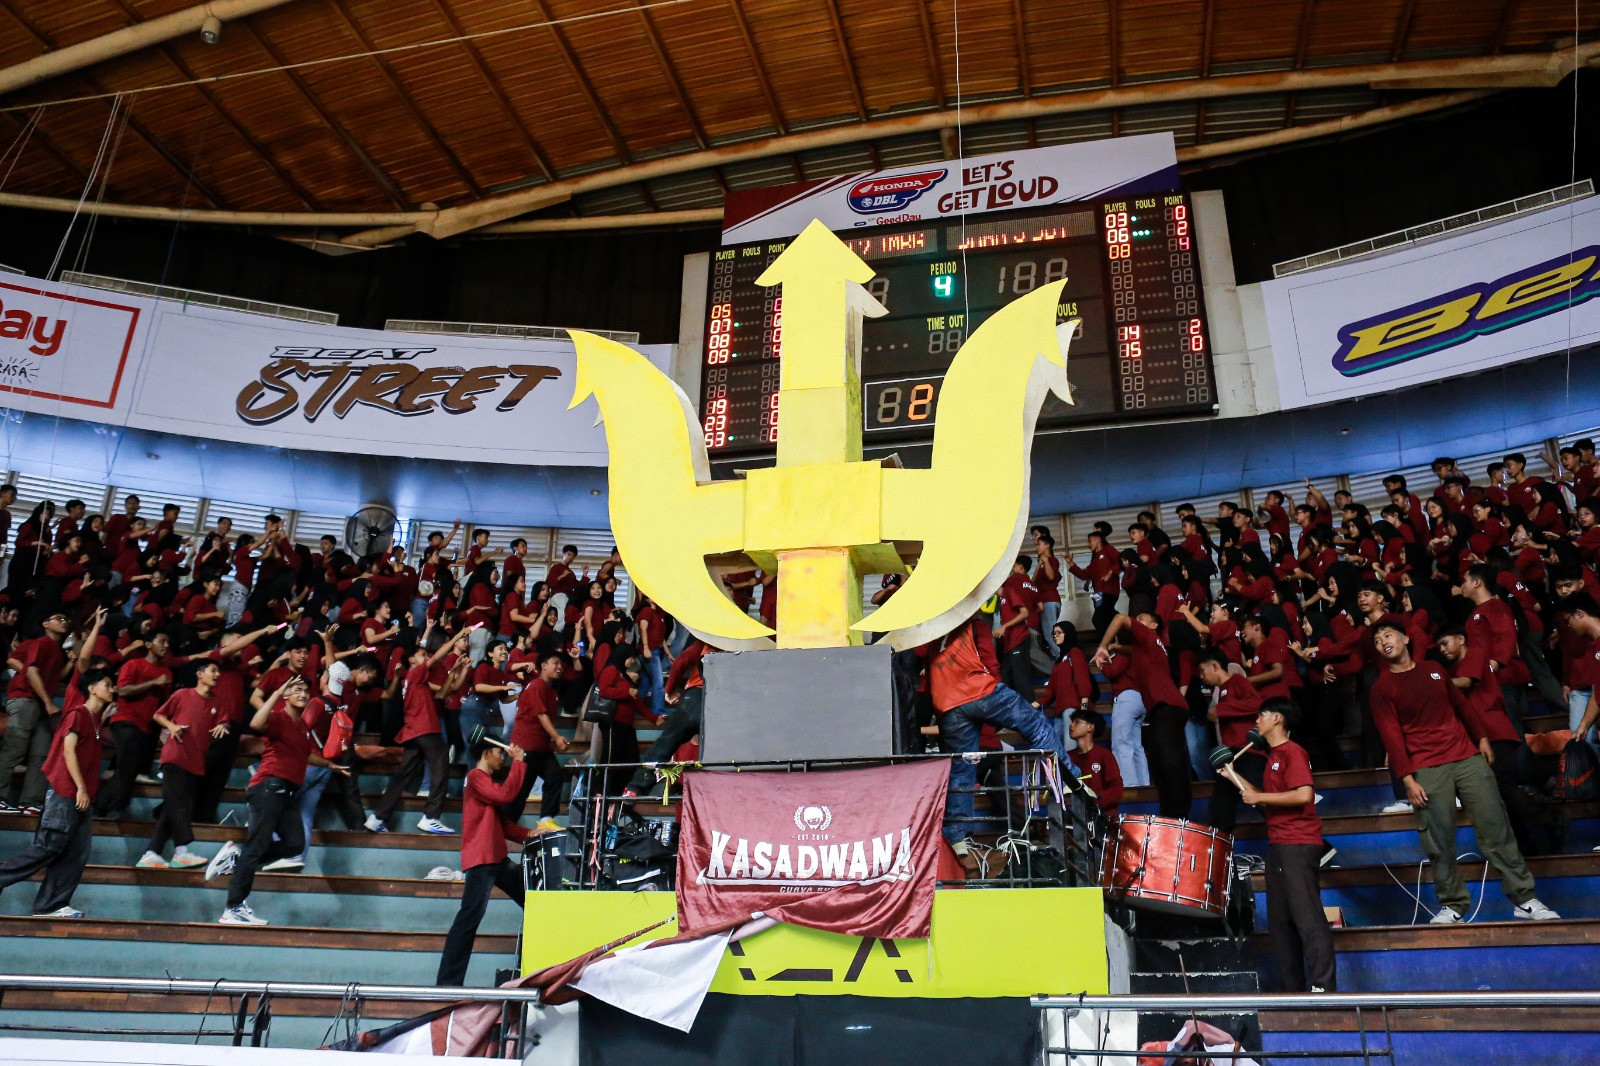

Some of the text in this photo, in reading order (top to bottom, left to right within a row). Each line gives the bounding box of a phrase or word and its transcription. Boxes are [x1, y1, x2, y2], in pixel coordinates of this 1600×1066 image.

[962, 160, 1015, 186] LET'S
[874, 181, 923, 192] HONDA
[938, 176, 1058, 213] GET LOUD
[873, 194, 898, 207] DBL
[1105, 195, 1183, 213] PLAYER FOULS POINT
[1106, 213, 1127, 228] 03
[1108, 221, 1187, 243] 06 2
[716, 244, 785, 261] PLAYER FOULS POINT
[1109, 237, 1189, 259] 08 4
[930, 262, 957, 275] PERIOD
[935, 276, 951, 297] 4
[711, 304, 731, 319] 05
[1057, 302, 1077, 317] OULS
[0, 298, 68, 356] ay
[710, 318, 731, 334] 07
[927, 315, 964, 330] TIME OUT
[1122, 319, 1200, 340] 14 2
[709, 333, 730, 349] 08
[708, 349, 729, 364] 09
[1123, 342, 1141, 357] 15
[235, 358, 562, 426] STREET
[711, 399, 727, 414] 19
[705, 415, 726, 431] 23
[707, 826, 911, 880] KASADWANA
